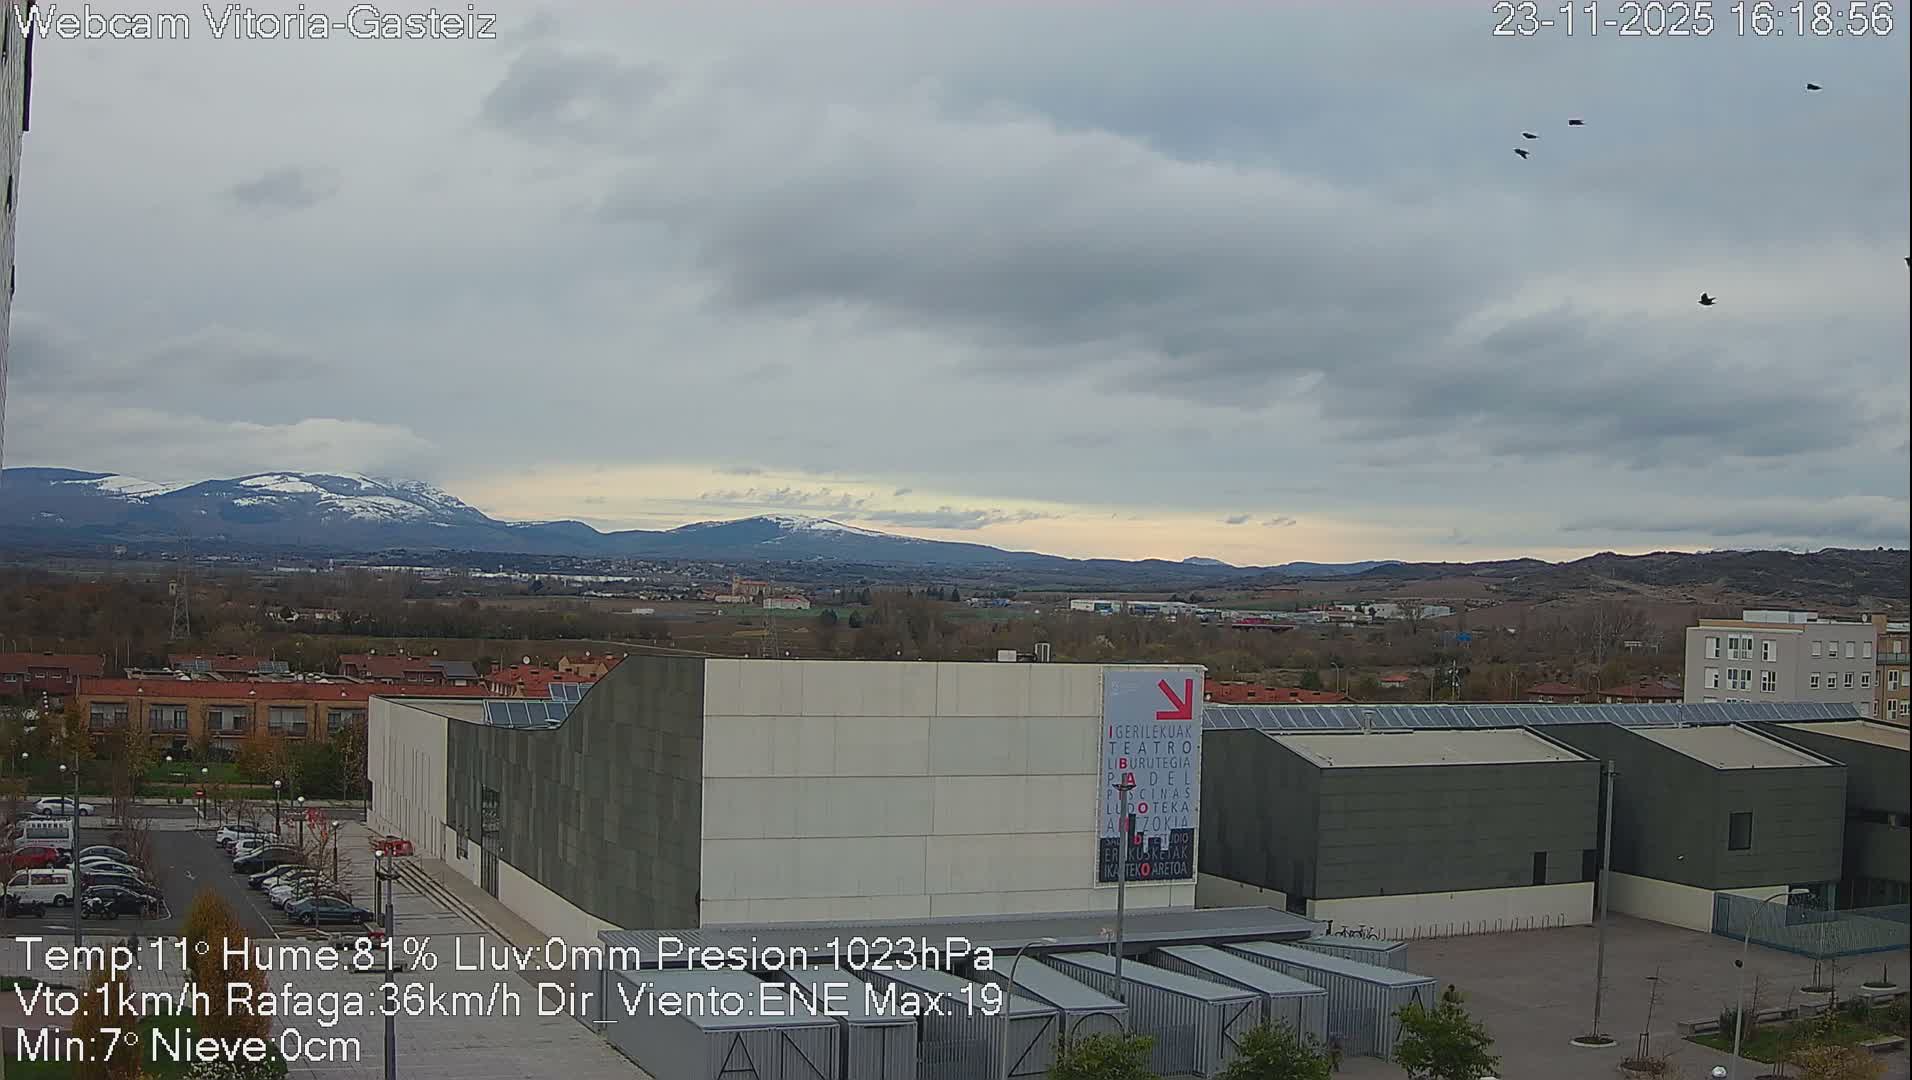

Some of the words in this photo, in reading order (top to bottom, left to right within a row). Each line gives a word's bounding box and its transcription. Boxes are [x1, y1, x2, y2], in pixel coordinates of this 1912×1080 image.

[1109, 725, 1192, 739] IGERILEKUAK
[1109, 741, 1192, 755] TEATRO
[1108, 757, 1190, 770] LIBURUTEGIA
[1107, 771, 1190, 786] PADEL
[1105, 847, 1188, 863] ERKUSKETAK
[1104, 862, 1151, 878] IKATEKO
